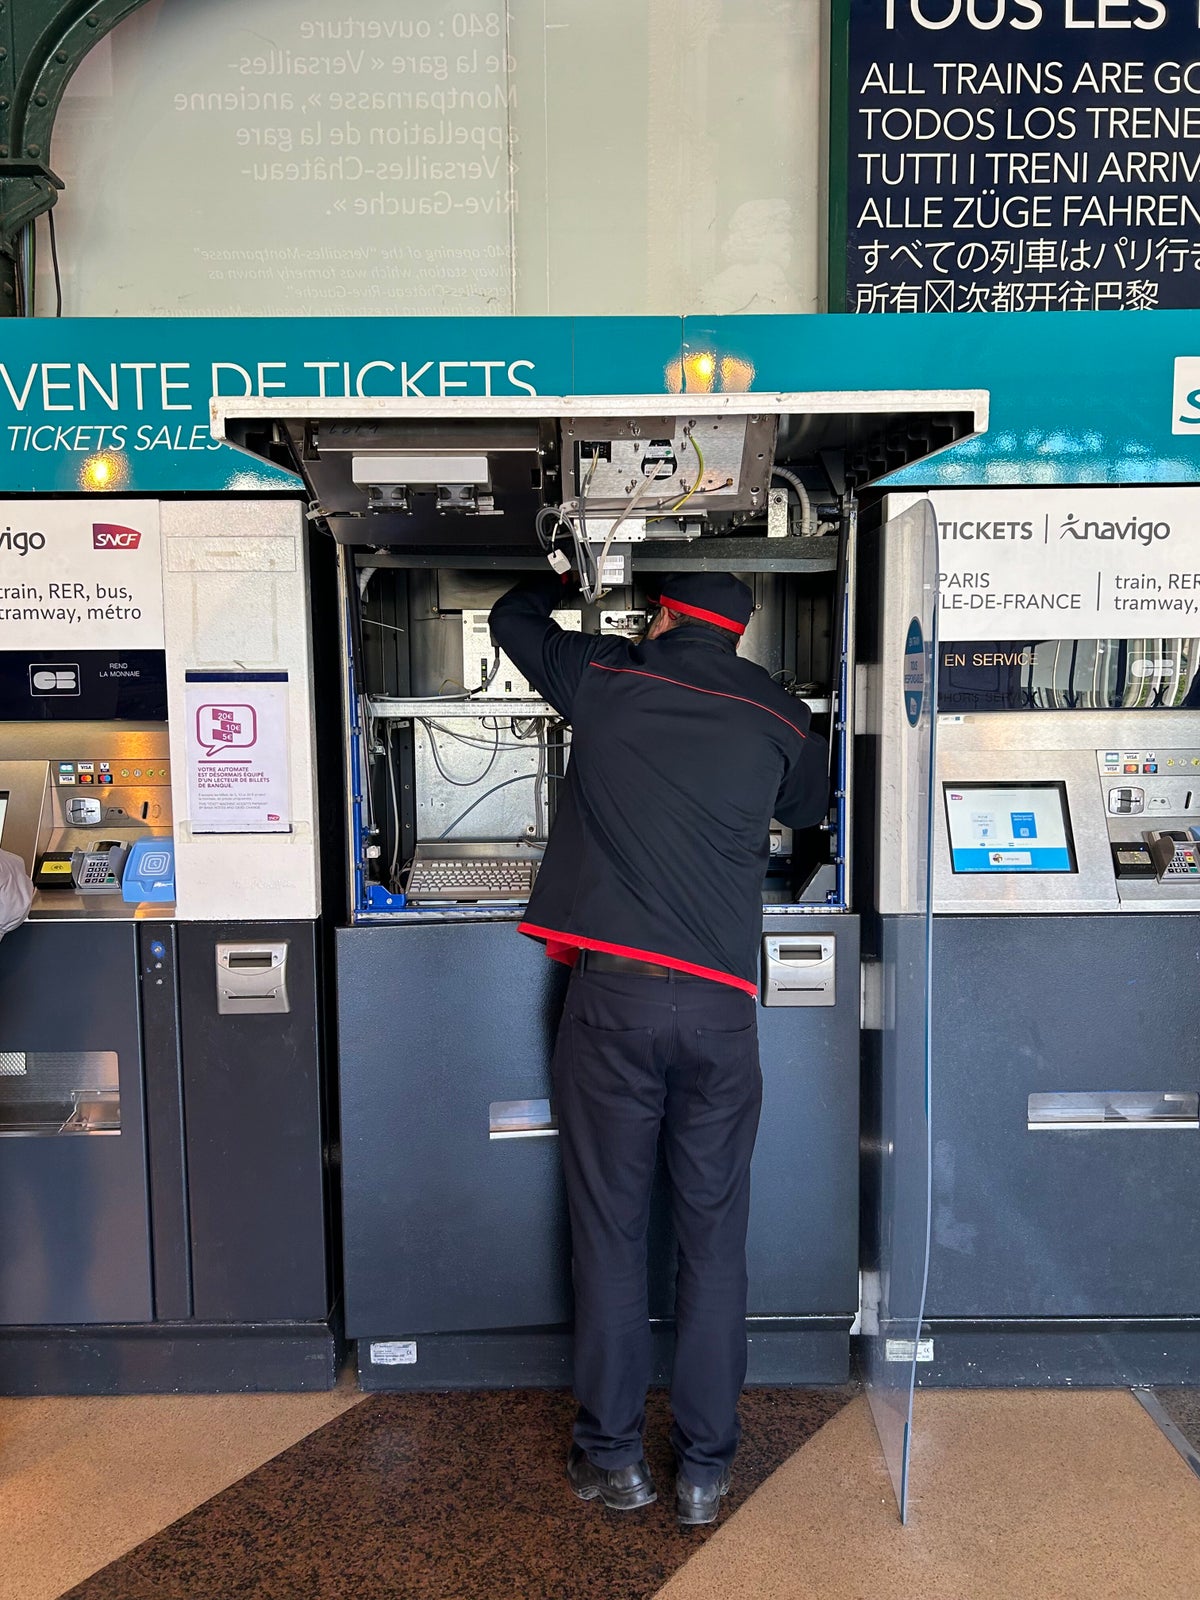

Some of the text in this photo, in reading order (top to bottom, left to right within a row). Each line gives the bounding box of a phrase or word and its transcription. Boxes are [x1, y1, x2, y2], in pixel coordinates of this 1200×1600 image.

[860, 62, 925, 94] ALL
[933, 61, 1063, 94] TRAINS
[1072, 62, 1144, 94] ARE
[859, 107, 1200, 141] TODOS LOS TRENE
[858, 153, 957, 185] TUTTI
[969, 153, 975, 185] I
[985, 152, 1088, 184] TRENI
[857, 189, 1200, 228] ALLE ZÜGE FAHREN
[0, 361, 536, 411] VENTE DE TICKETS
[7, 425, 126, 451] TICKETS
[938, 521, 1033, 540] TICKETS
[1084, 516, 1171, 546] navigo
[95, 533, 139, 547] SNCF
[935, 572, 990, 588] PARIS
[1115, 574, 1162, 591] train,
[49, 583, 91, 602] RER,
[96, 583, 133, 602] bus,
[87, 604, 142, 620] métro
[1114, 596, 1199, 614] tramway,
[945, 652, 1039, 667] EN SERVICE
[110, 670, 140, 678] MONNAIE
[217, 712, 233, 720] 20€
[222, 733, 233, 741] 5€
[226, 724, 241, 732] 10€
